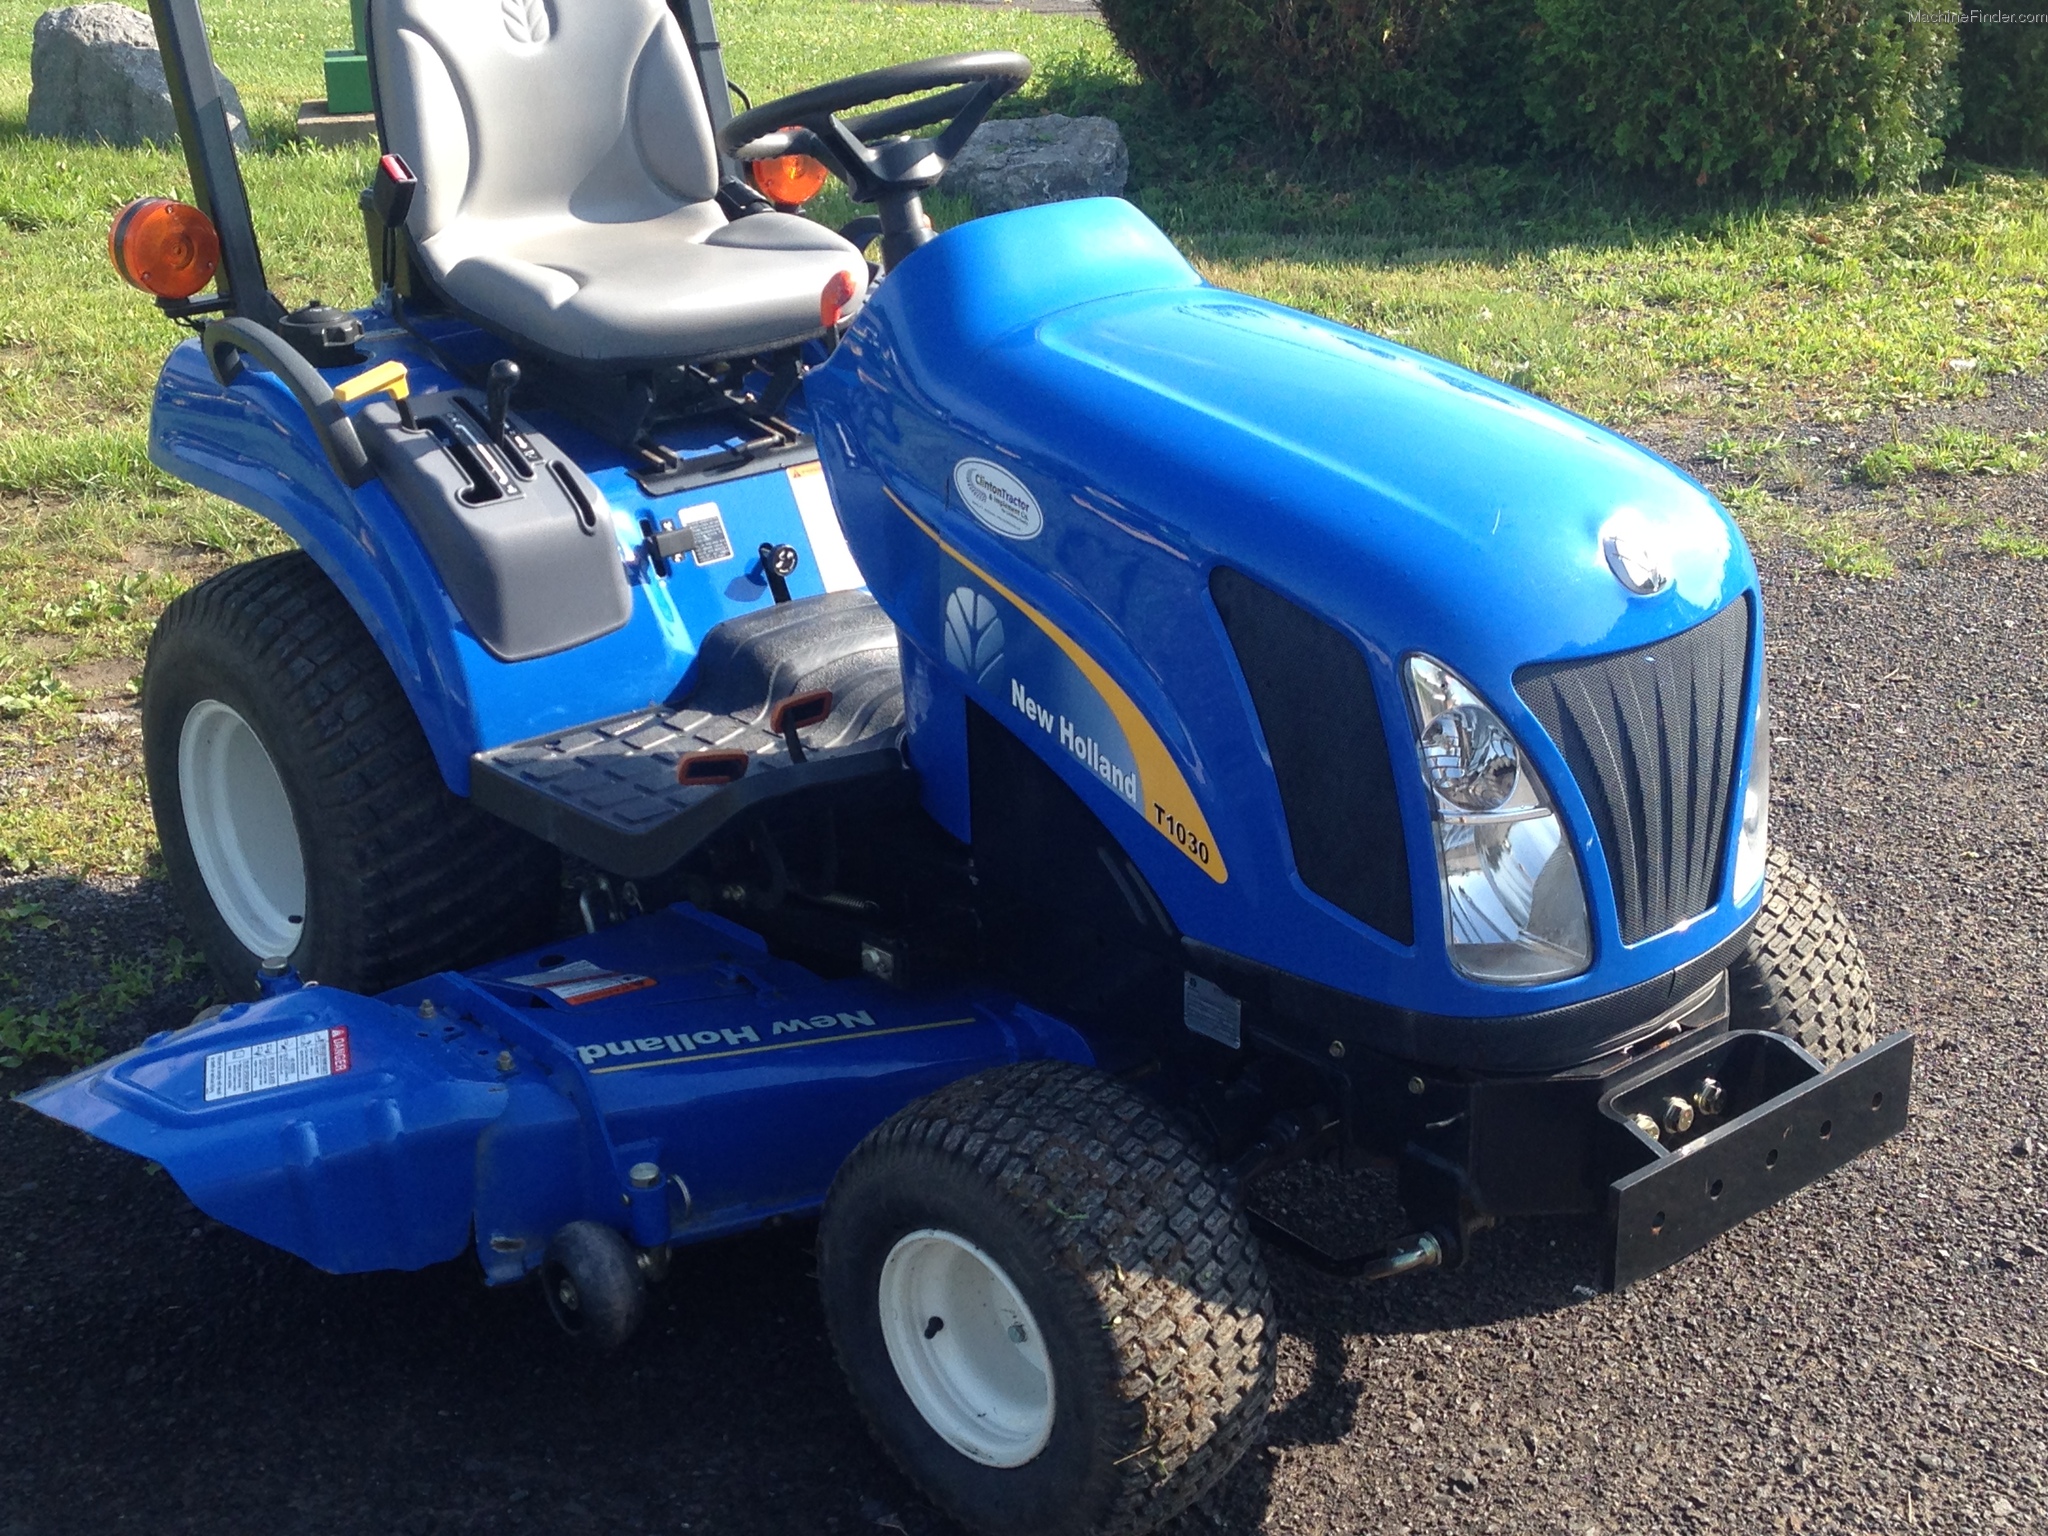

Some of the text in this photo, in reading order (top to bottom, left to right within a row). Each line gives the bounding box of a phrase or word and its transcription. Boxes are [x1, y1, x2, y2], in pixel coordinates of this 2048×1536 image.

[1010, 678, 1138, 804] New Holland
[1153, 802, 1210, 865] T1030
[333, 1037, 347, 1072] DANGER
[577, 1009, 876, 1065] New Holland
